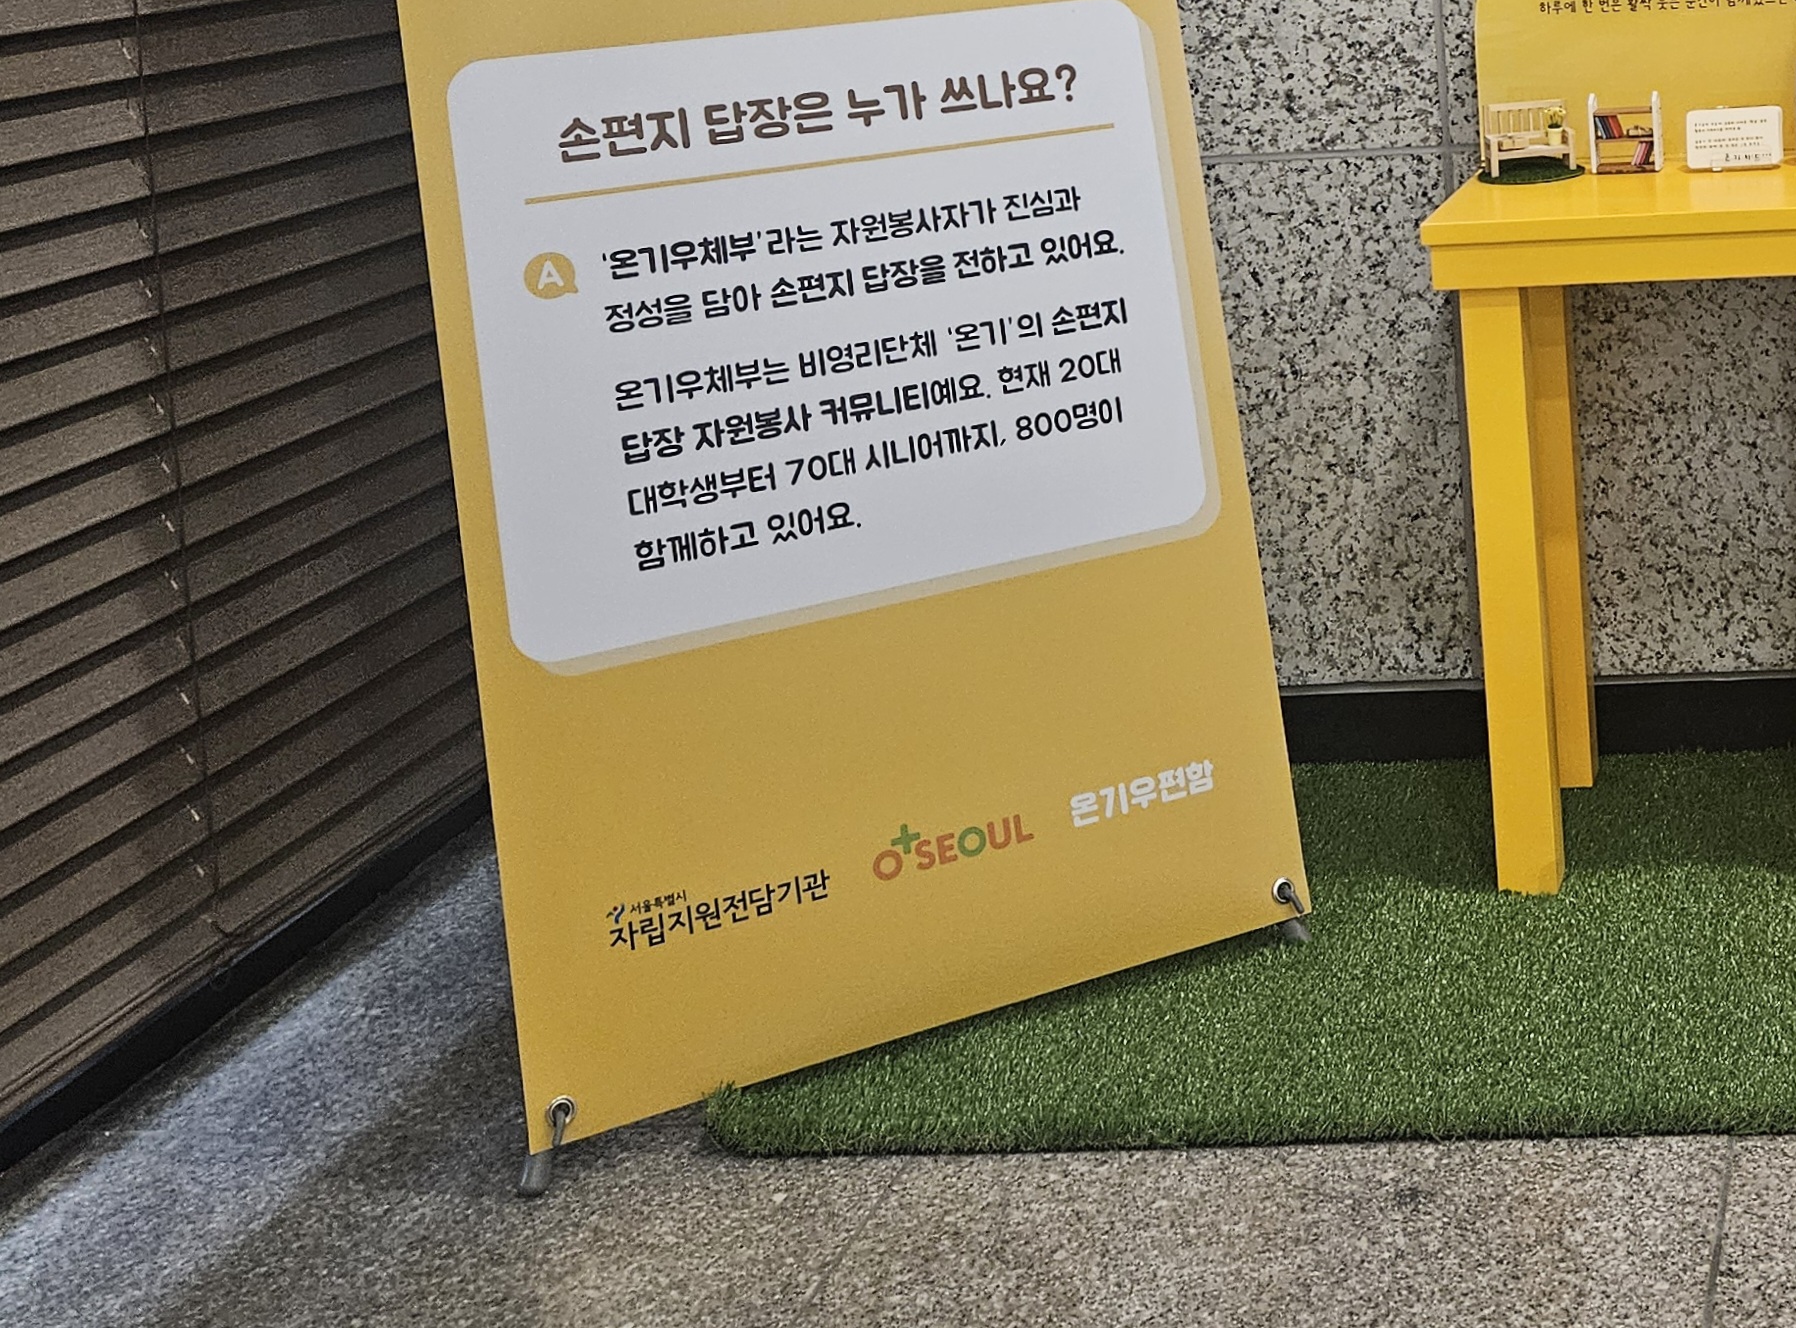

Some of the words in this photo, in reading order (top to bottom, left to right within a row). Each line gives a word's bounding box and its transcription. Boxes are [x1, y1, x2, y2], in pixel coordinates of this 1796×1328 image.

[1539, 0, 1576, 15] 하루에
[557, 107, 691, 163] 손편지
[705, 92, 834, 146] 답장은
[847, 81, 926, 127] 누가
[940, 64, 1078, 113] 쓰나요?
[830, 201, 996, 246] 자원봉사자가
[1004, 187, 1081, 222] 진심과
[535, 262, 565, 289] A
[604, 294, 692, 333] 정성을
[702, 283, 761, 318] 담아
[770, 269, 855, 308] 손편지
[862, 254, 947, 294] 답장을
[953, 242, 1034, 279] 전하고
[1041, 230, 1125, 264] 있어요.
[614, 357, 790, 411] 온기우체부는
[799, 330, 938, 377] 비영리단체
[1051, 298, 1129, 337] 손편지
[621, 426, 685, 465] 답장
[693, 402, 811, 451] 자원봉사
[820, 373, 993, 424] 커뮤니티예요.
[997, 359, 1052, 396] 현재
[1059, 348, 1123, 384] 20대
[627, 462, 777, 517] 대학생부터
[785, 448, 857, 487] 70대
[865, 420, 1006, 472] 시니어까지,
[1015, 396, 1124, 441] 800명이
[633, 521, 760, 571] 함께하고
[767, 502, 862, 544] 있어요.
[1068, 758, 1215, 828] 온기우편함
[609, 869, 831, 951] 자립지원전담기관
[630, 890, 687, 915] 서울특별시
